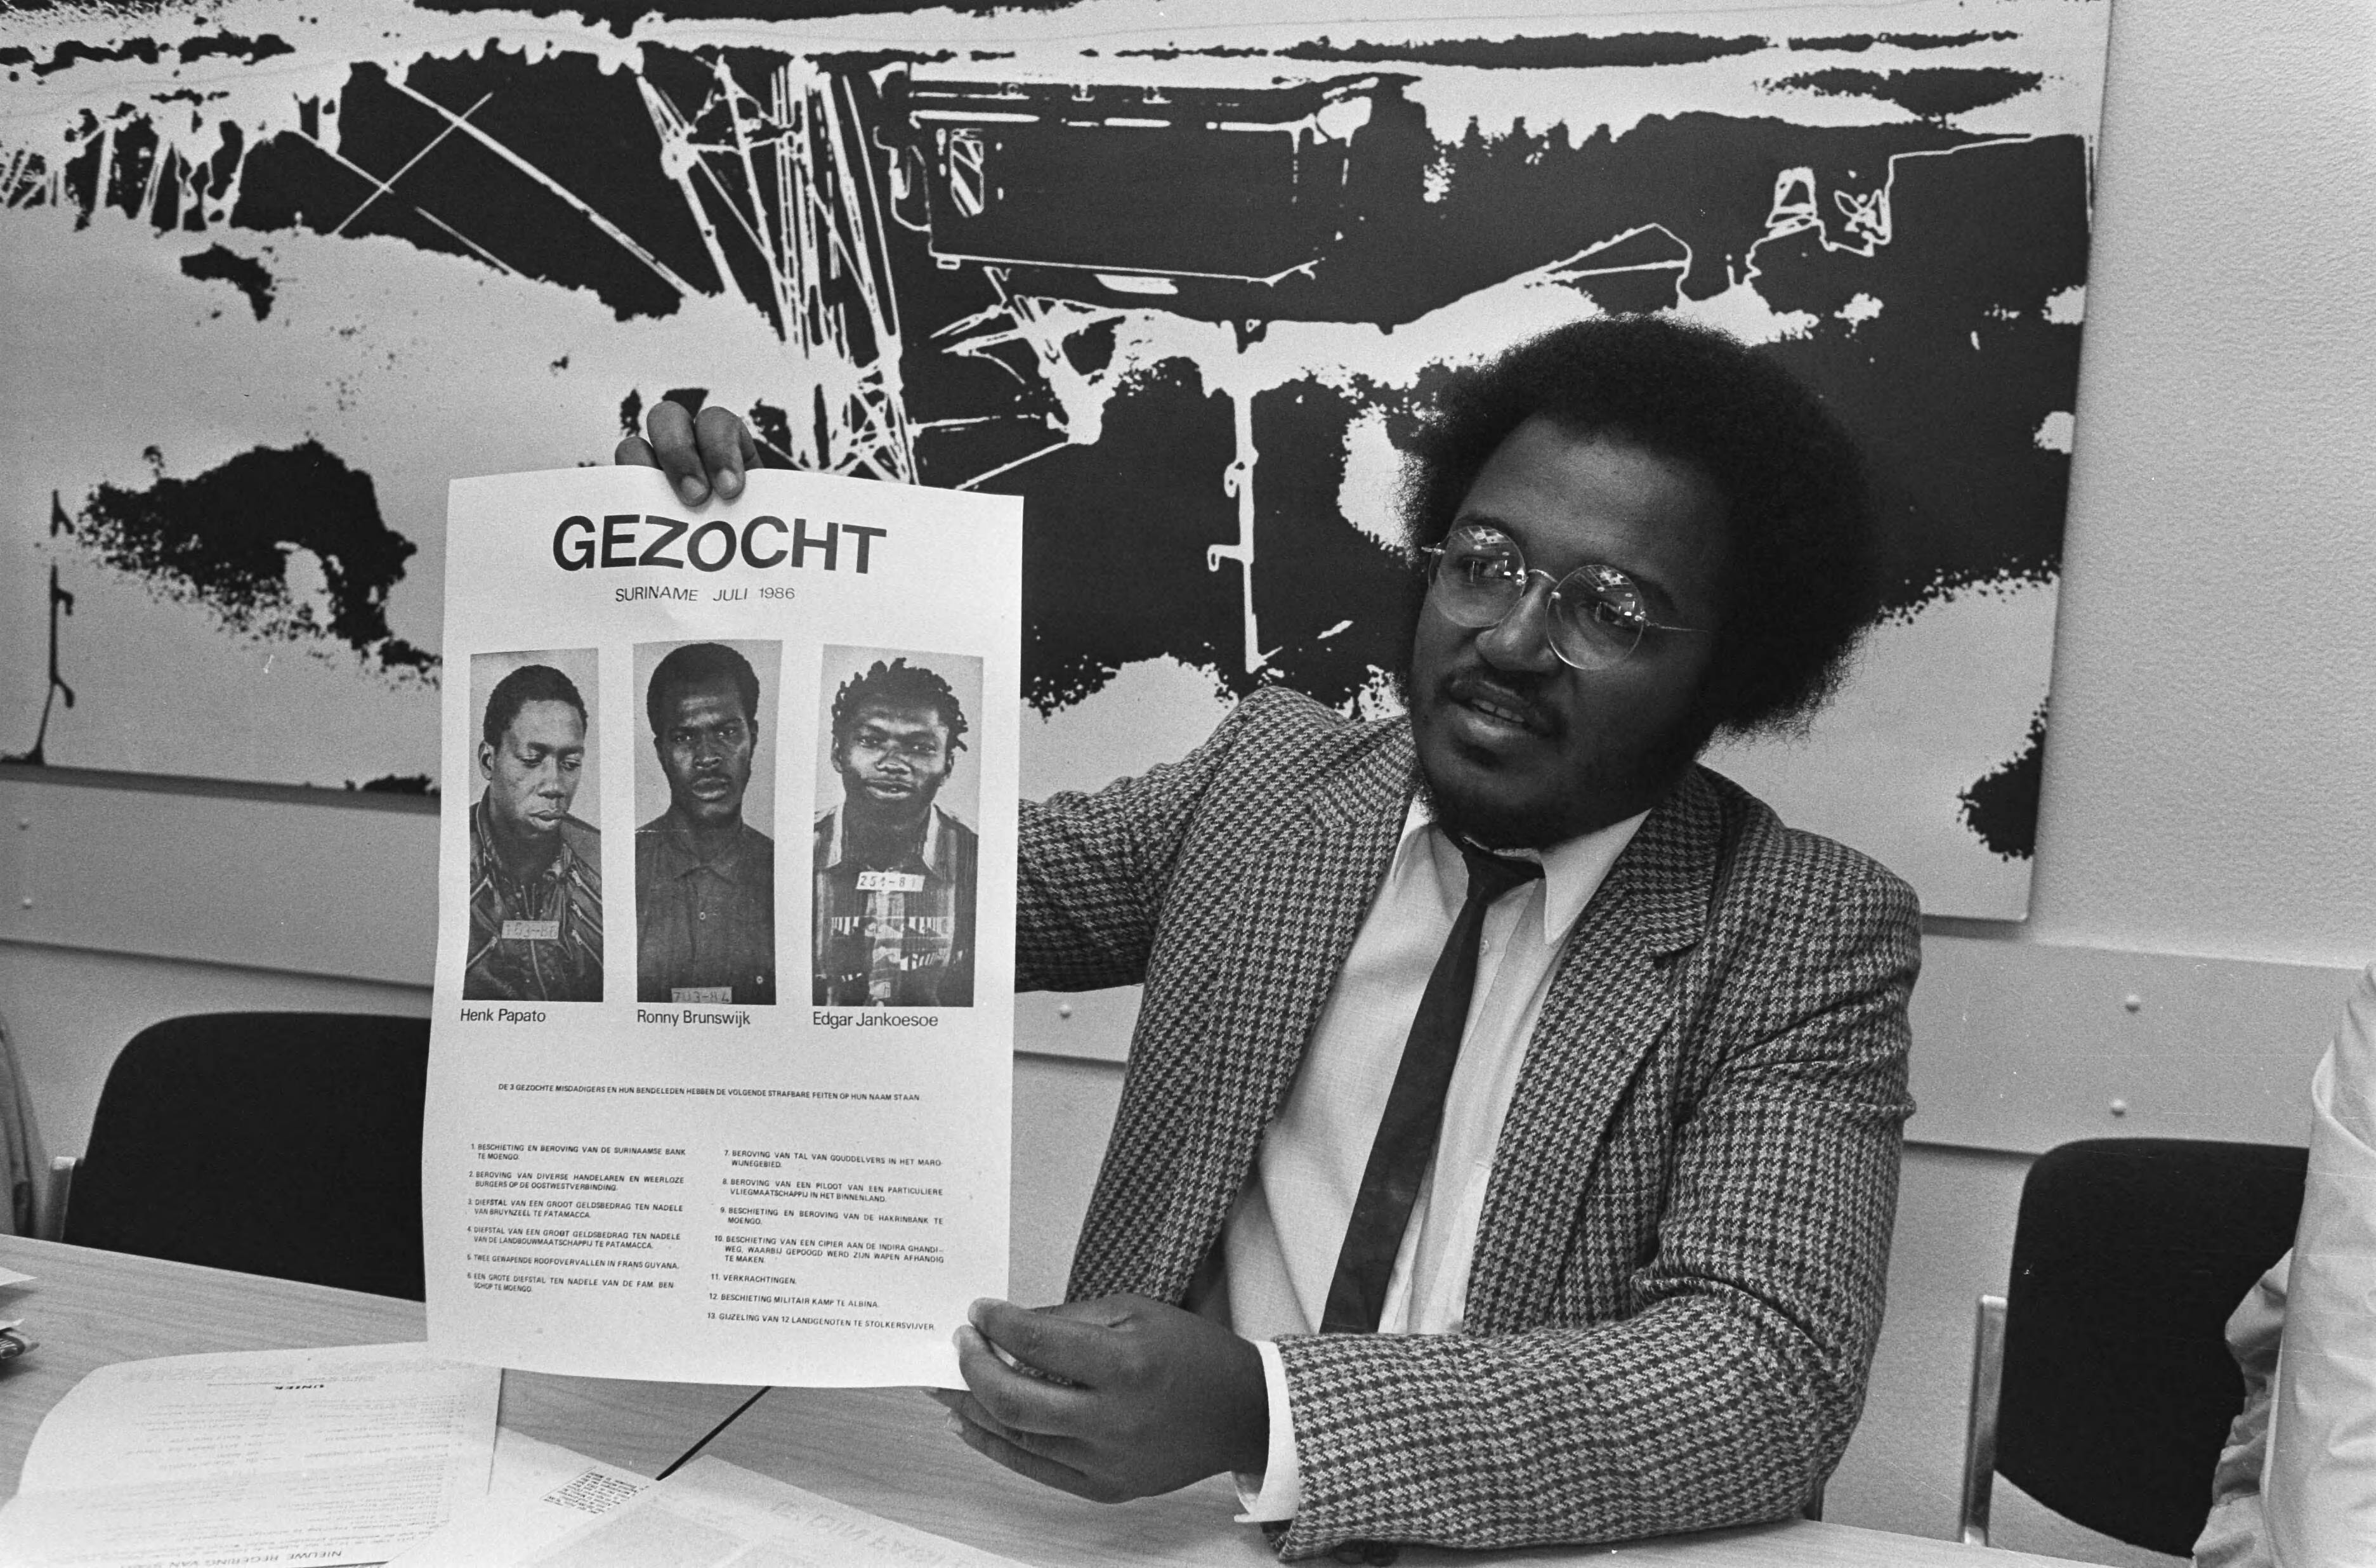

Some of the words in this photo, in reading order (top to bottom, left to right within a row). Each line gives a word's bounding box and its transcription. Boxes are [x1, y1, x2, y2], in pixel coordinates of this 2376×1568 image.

[553, 514, 887, 574] GEZOCHT
[615, 586, 697, 602] SURINAME
[713, 587, 748, 601] JULI
[759, 587, 796, 599] 1986
[460, 1009, 494, 1022] Henk
[498, 1009, 546, 1025] Papato
[637, 1010, 679, 1026] Ronny
[683, 1010, 751, 1028] Brunswijk
[813, 1011, 853, 1029] Edgar
[856, 1012, 938, 1026] Jankoesoe
[768, 1090, 810, 1098] STRAFBARE
[614, 1147, 662, 1155] SURINAAMSE
[732, 1150, 770, 1158] BEROVING
[830, 1154, 885, 1164] GOUDDELVERS
[730, 1179, 770, 1187] BEROVING
[888, 1187, 943, 1196] PARTICULIERE
[730, 1189, 808, 1198] VLIEGMAATSCHAPPIJ
[576, 1201, 631, 1210] GELDSBEDRAG
[728, 1207, 778, 1216] BESCHIETING
[799, 1210, 839, 1219] BEROVING
[879, 1215, 929, 1224] HAKRINBANK
[499, 1238, 593, 1247] LANDBOUWMAATSCHAPPIJ
[726, 1236, 776, 1245] BESCHIETING
[786, 1248, 823, 1257] GEPOOGD
[903, 1255, 944, 1264] AFHANDIG
[534, 1257, 605, 1267] ROOFOVERVALLEN
[617, 1260, 643, 1269] FRANS
[513, 1276, 546, 1284] DIEFSTAL
[721, 1293, 771, 1303] BESCHIETING
[719, 1313, 759, 1321] GIJZELING
[792, 1317, 851, 1326] LANDGENOTEN
